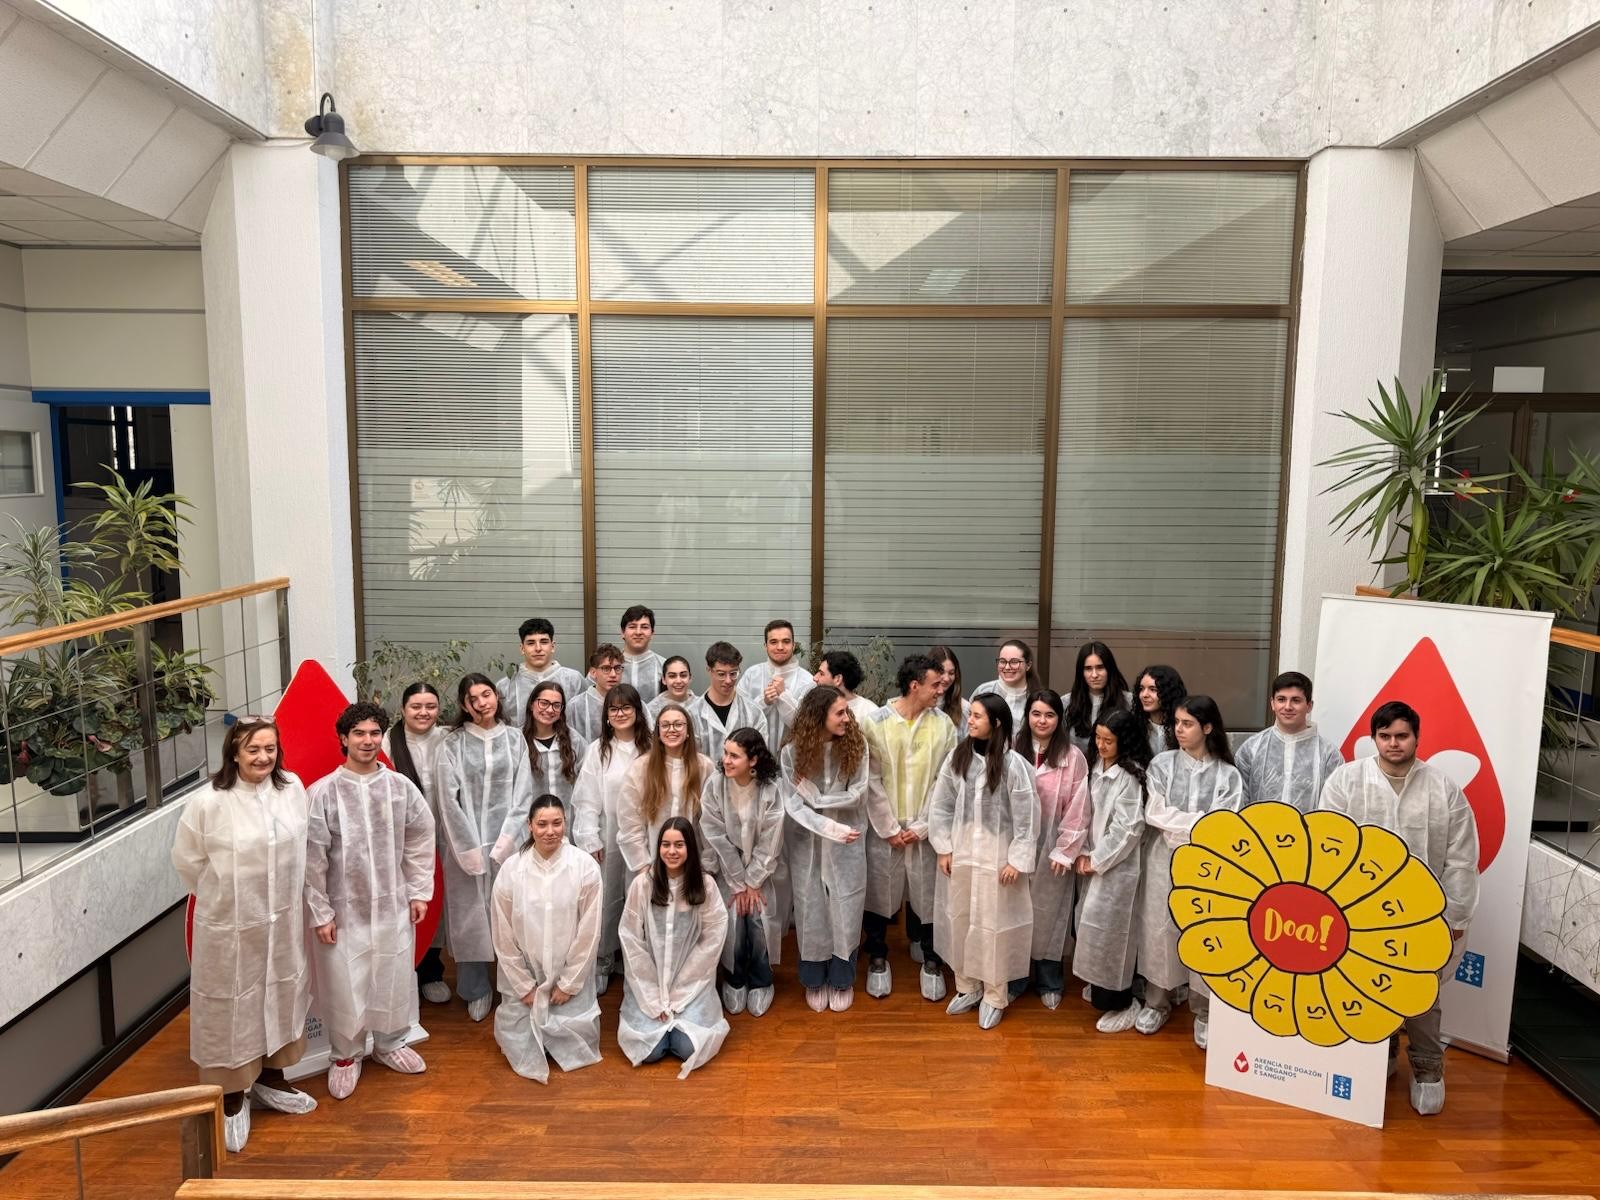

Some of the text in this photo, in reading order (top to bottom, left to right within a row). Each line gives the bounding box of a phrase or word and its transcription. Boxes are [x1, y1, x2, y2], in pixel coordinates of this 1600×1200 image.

[1264, 907, 1335, 952] Doa!
[1254, 1057, 1283, 1068] AXENCIA
[1284, 1063, 1293, 1071] DE
[1259, 1070, 1286, 1082] SANGUE
